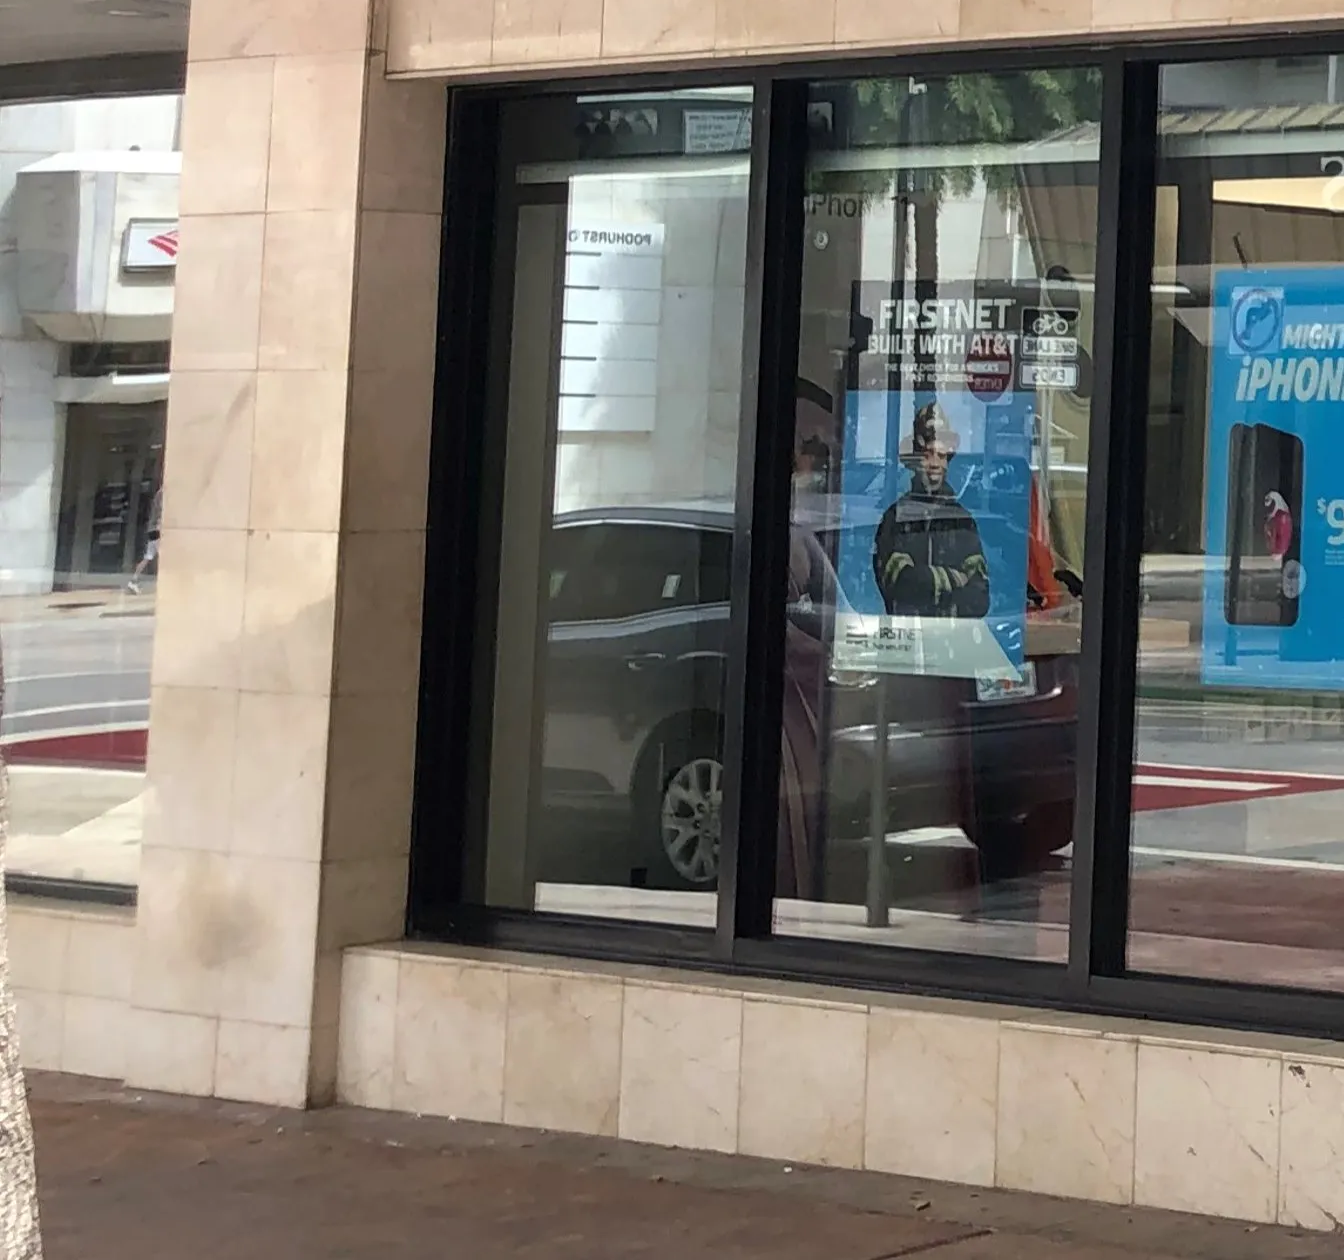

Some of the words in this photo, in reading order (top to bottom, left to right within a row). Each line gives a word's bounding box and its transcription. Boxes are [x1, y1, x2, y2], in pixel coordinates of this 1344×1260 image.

[880, 298, 1012, 330] FIRSTNET
[868, 334, 915, 355] BUILT
[919, 334, 965, 355] WITH
[970, 334, 1018, 355] AT&T
